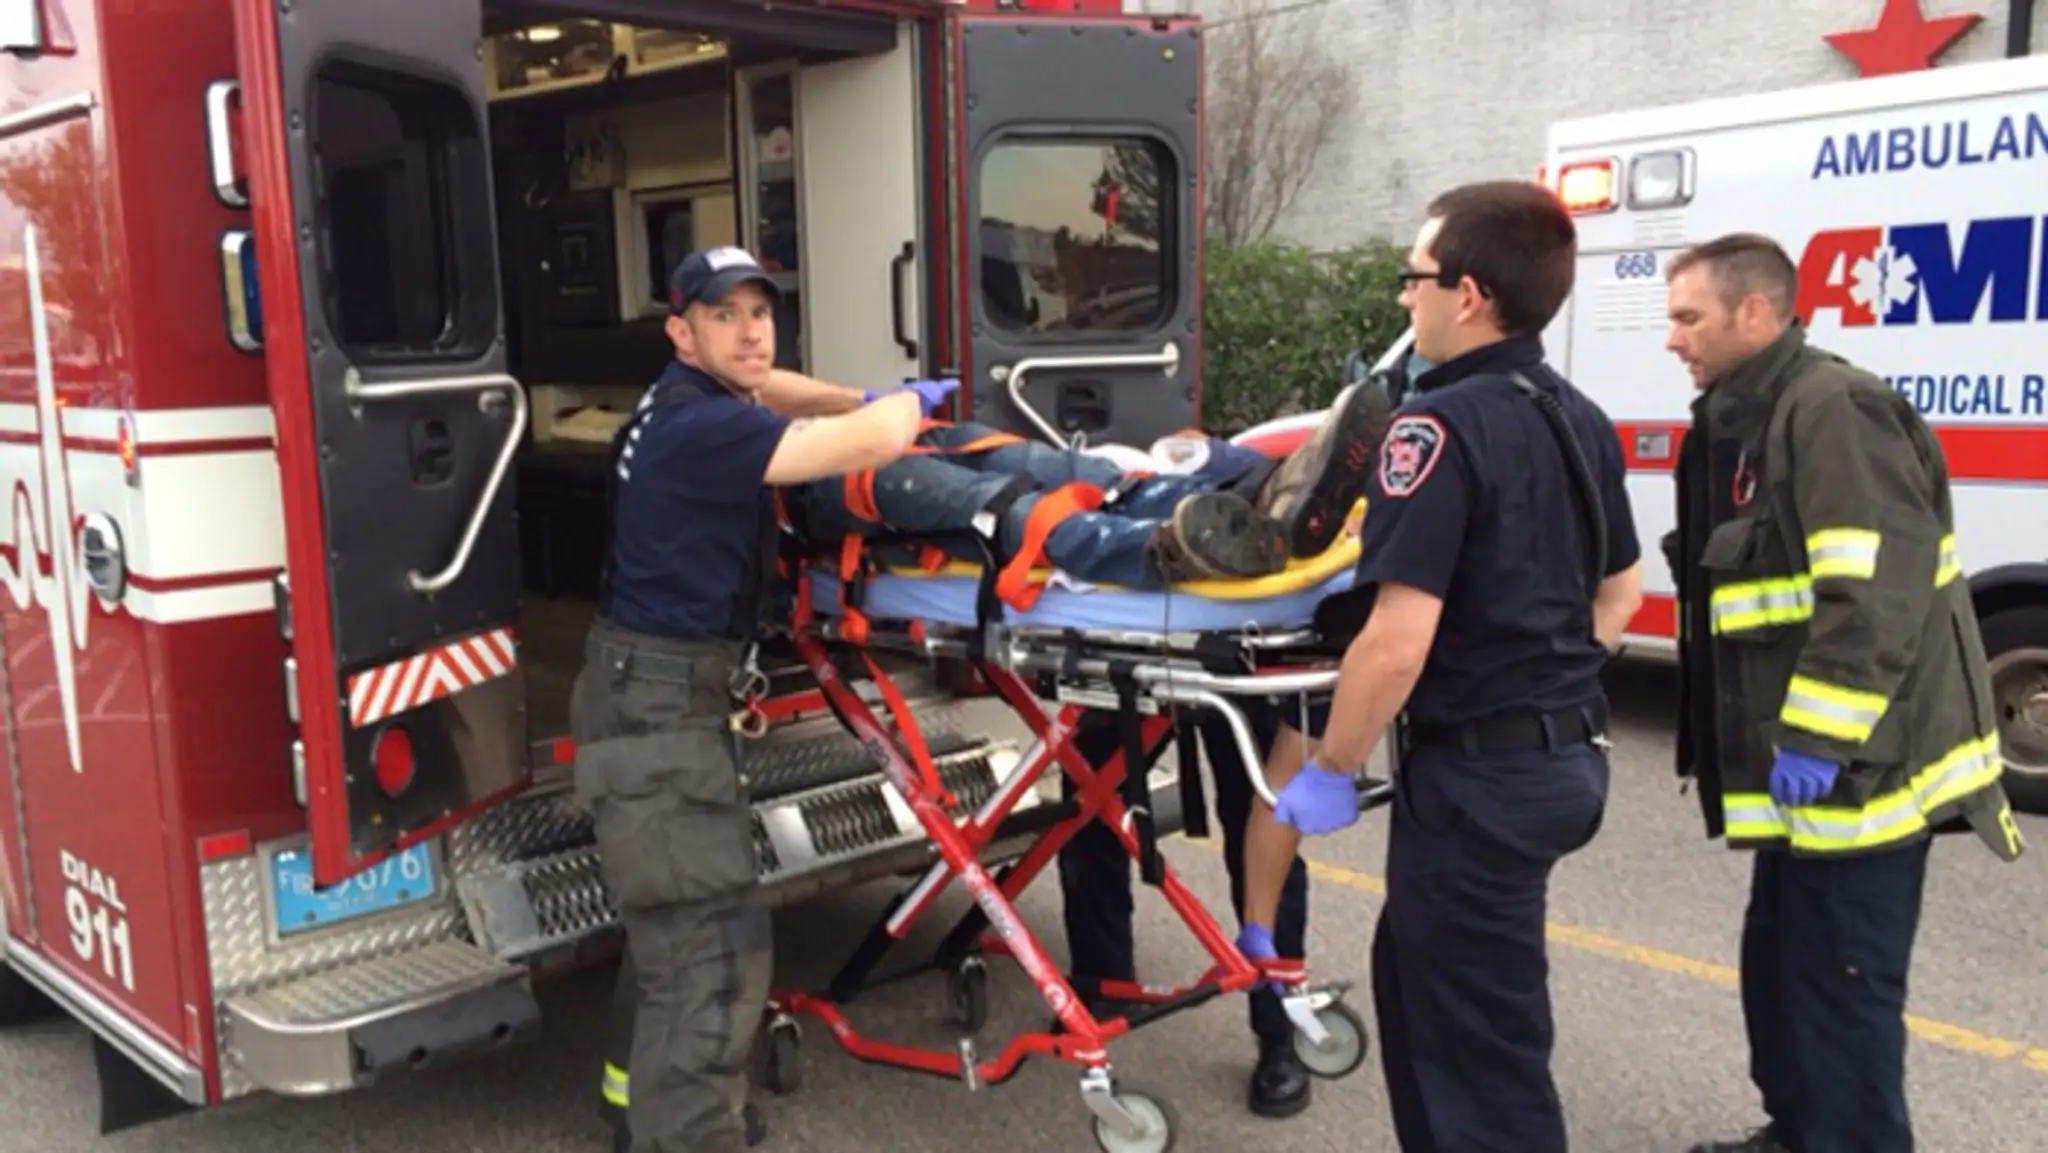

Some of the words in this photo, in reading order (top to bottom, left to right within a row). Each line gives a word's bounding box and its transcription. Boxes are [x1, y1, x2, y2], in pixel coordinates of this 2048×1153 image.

[1615, 251, 1656, 279] 668
[1793, 214, 2048, 327] AM
[59, 848, 127, 913] DIAL
[64, 885, 135, 993] 911
